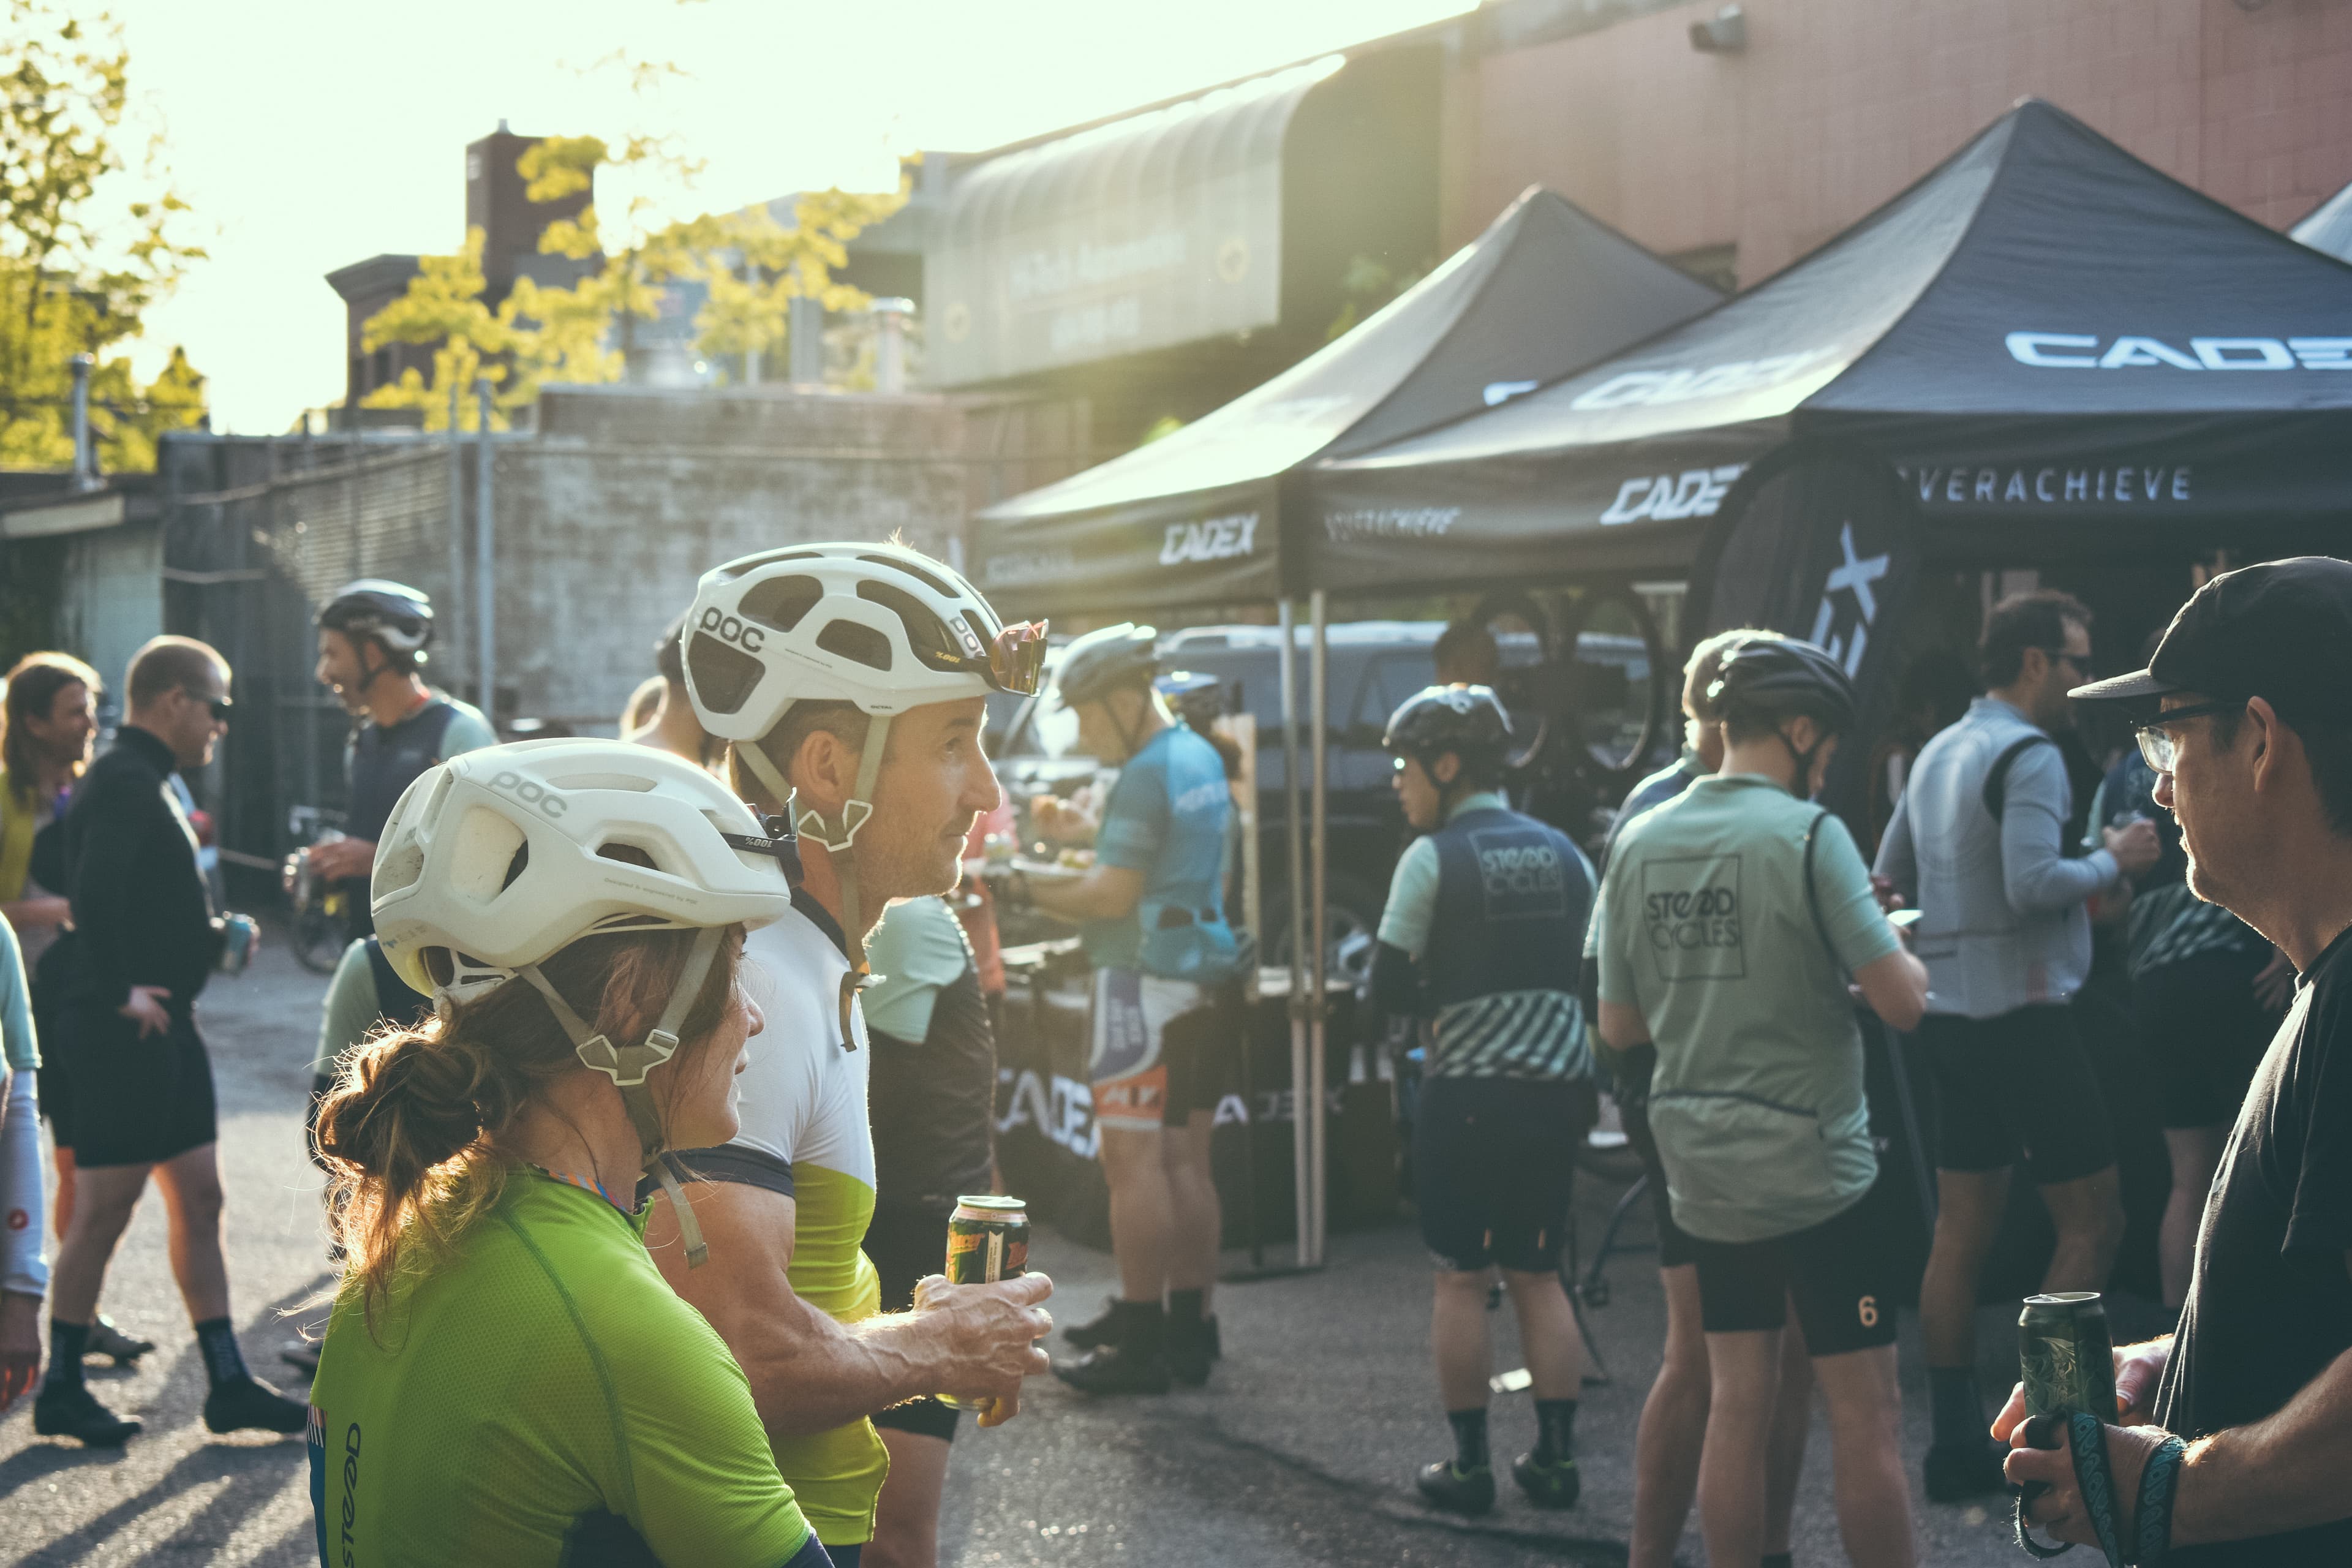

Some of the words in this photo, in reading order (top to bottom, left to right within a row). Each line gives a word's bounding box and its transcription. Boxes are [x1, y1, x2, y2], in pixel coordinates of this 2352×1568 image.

[1599, 462, 1752, 525] CADE
[1897, 467, 2192, 502] VERACHIEVE
[1159, 512, 1260, 565] CADEX
[745, 837, 773, 848] 100%
[1653, 920, 1739, 950] CYCLES
[1858, 1295, 1879, 1328] 6
